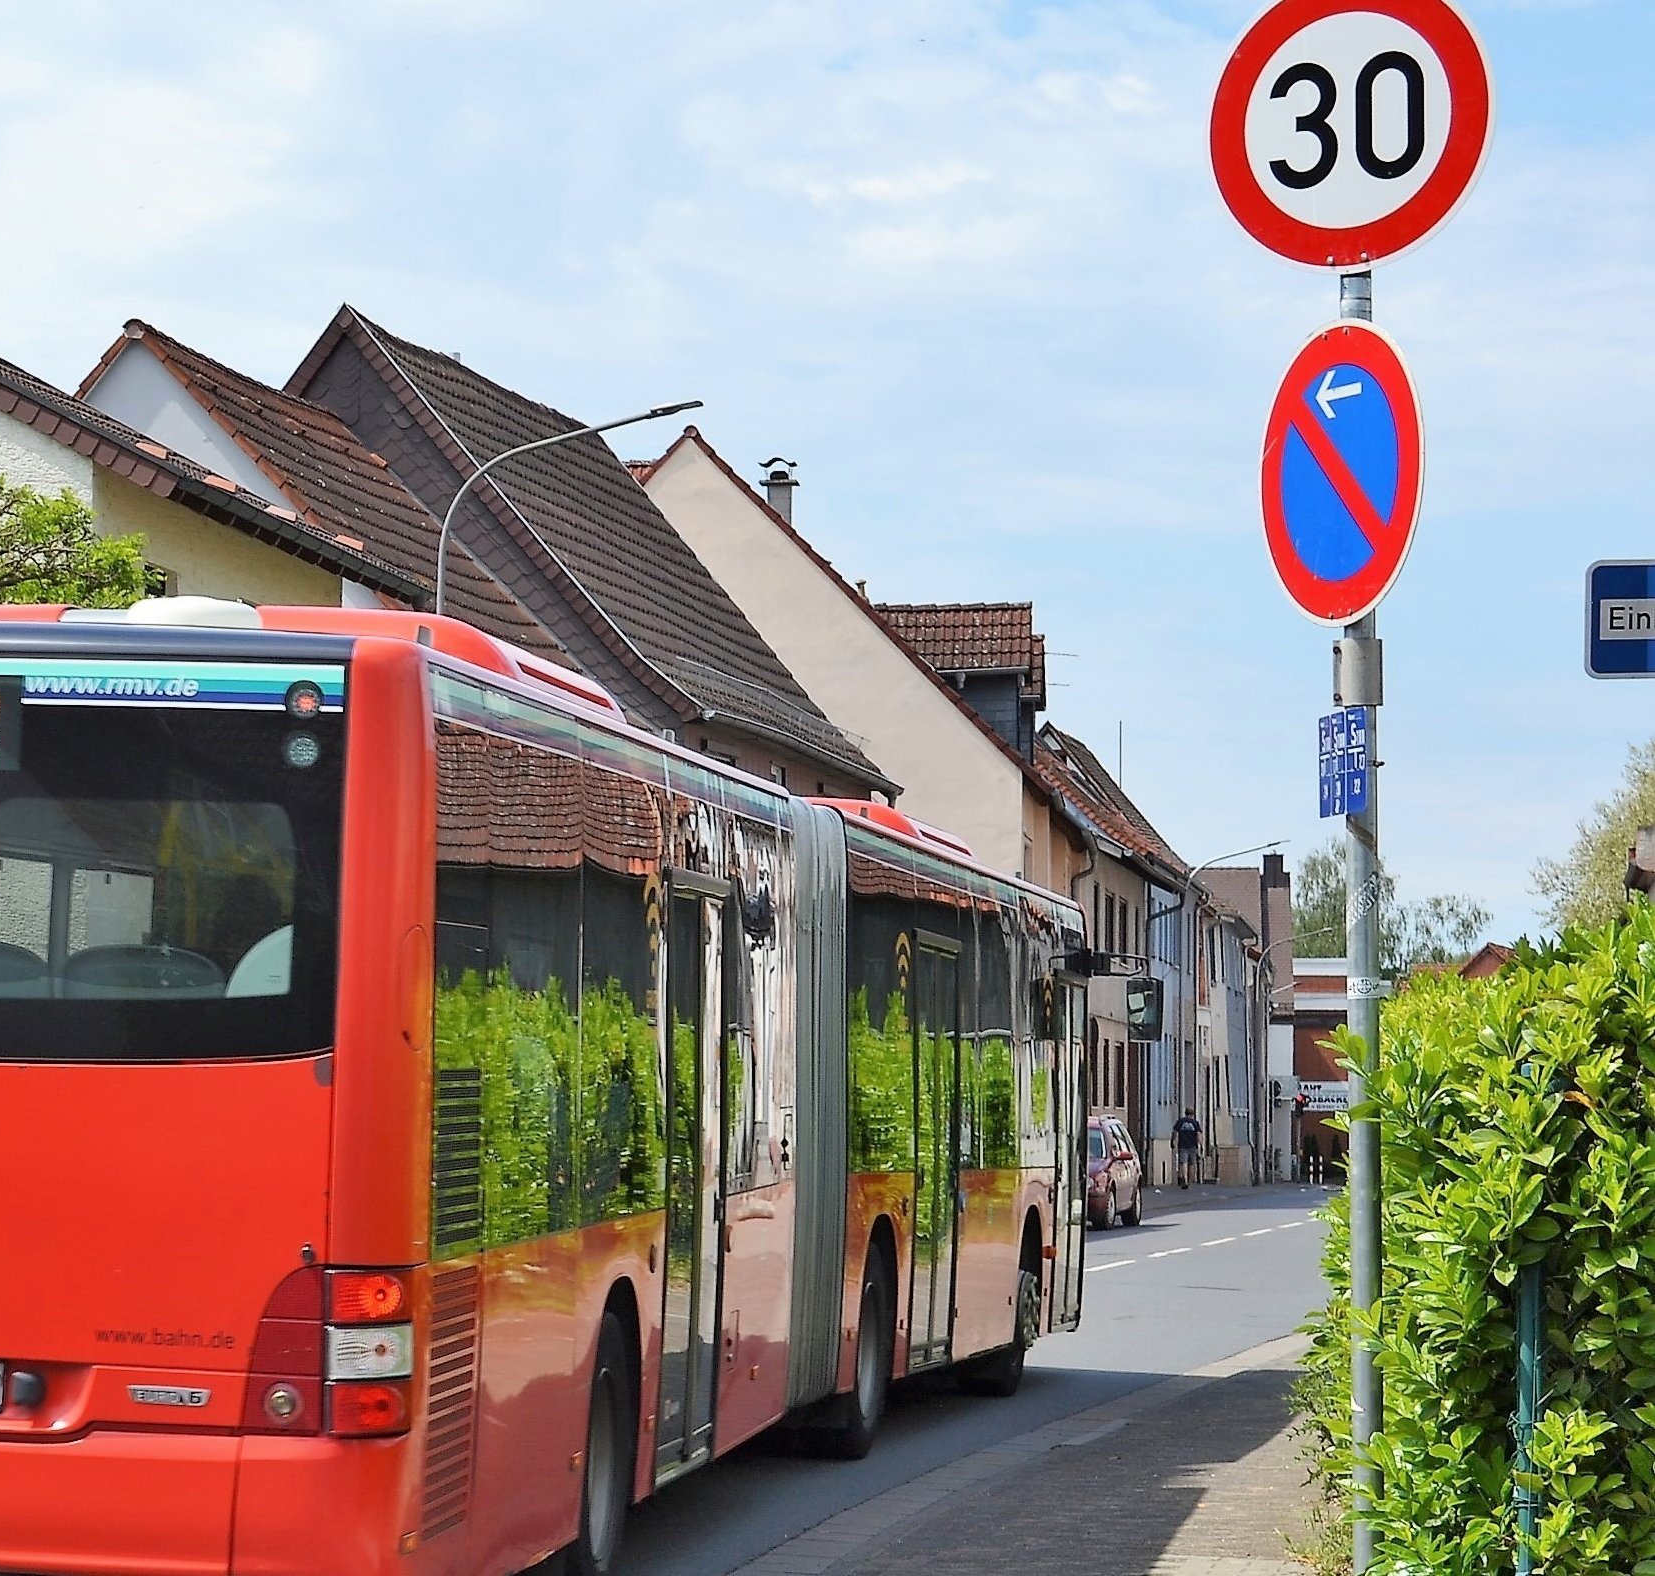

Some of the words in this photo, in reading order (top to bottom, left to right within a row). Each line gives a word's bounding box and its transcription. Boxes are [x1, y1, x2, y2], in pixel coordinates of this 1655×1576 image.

[1269, 50, 1425, 190] 30
[1609, 606, 1655, 630] Ein
[25, 674, 199, 697] www.rmv.de
[96, 1328, 236, 1349] www.bahn.de
[190, 1391, 201, 1404] 6
